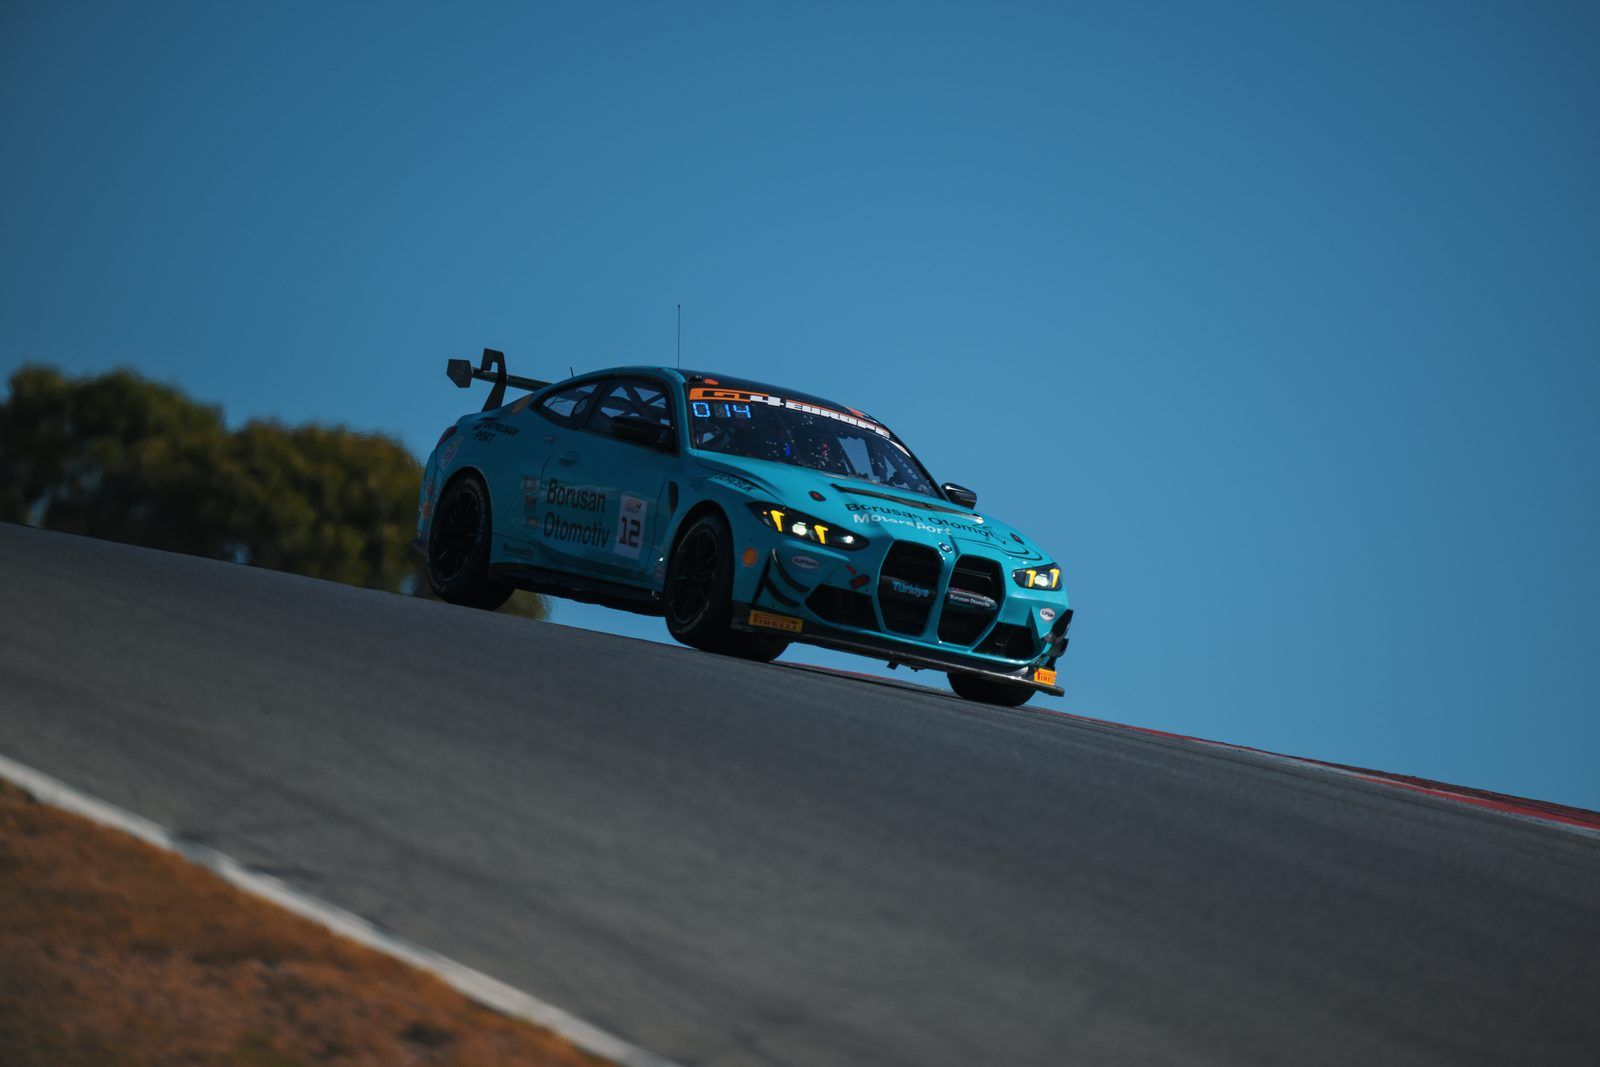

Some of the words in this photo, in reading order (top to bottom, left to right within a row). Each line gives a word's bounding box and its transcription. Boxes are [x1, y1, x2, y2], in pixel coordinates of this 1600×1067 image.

[546, 478, 606, 514] Borusan
[845, 502, 924, 522] Borusan
[853, 513, 952, 536] Motorsport
[543, 511, 610, 548] Otomotiv
[618, 516, 641, 548] 12
[753, 613, 799, 630] PIRELLI
